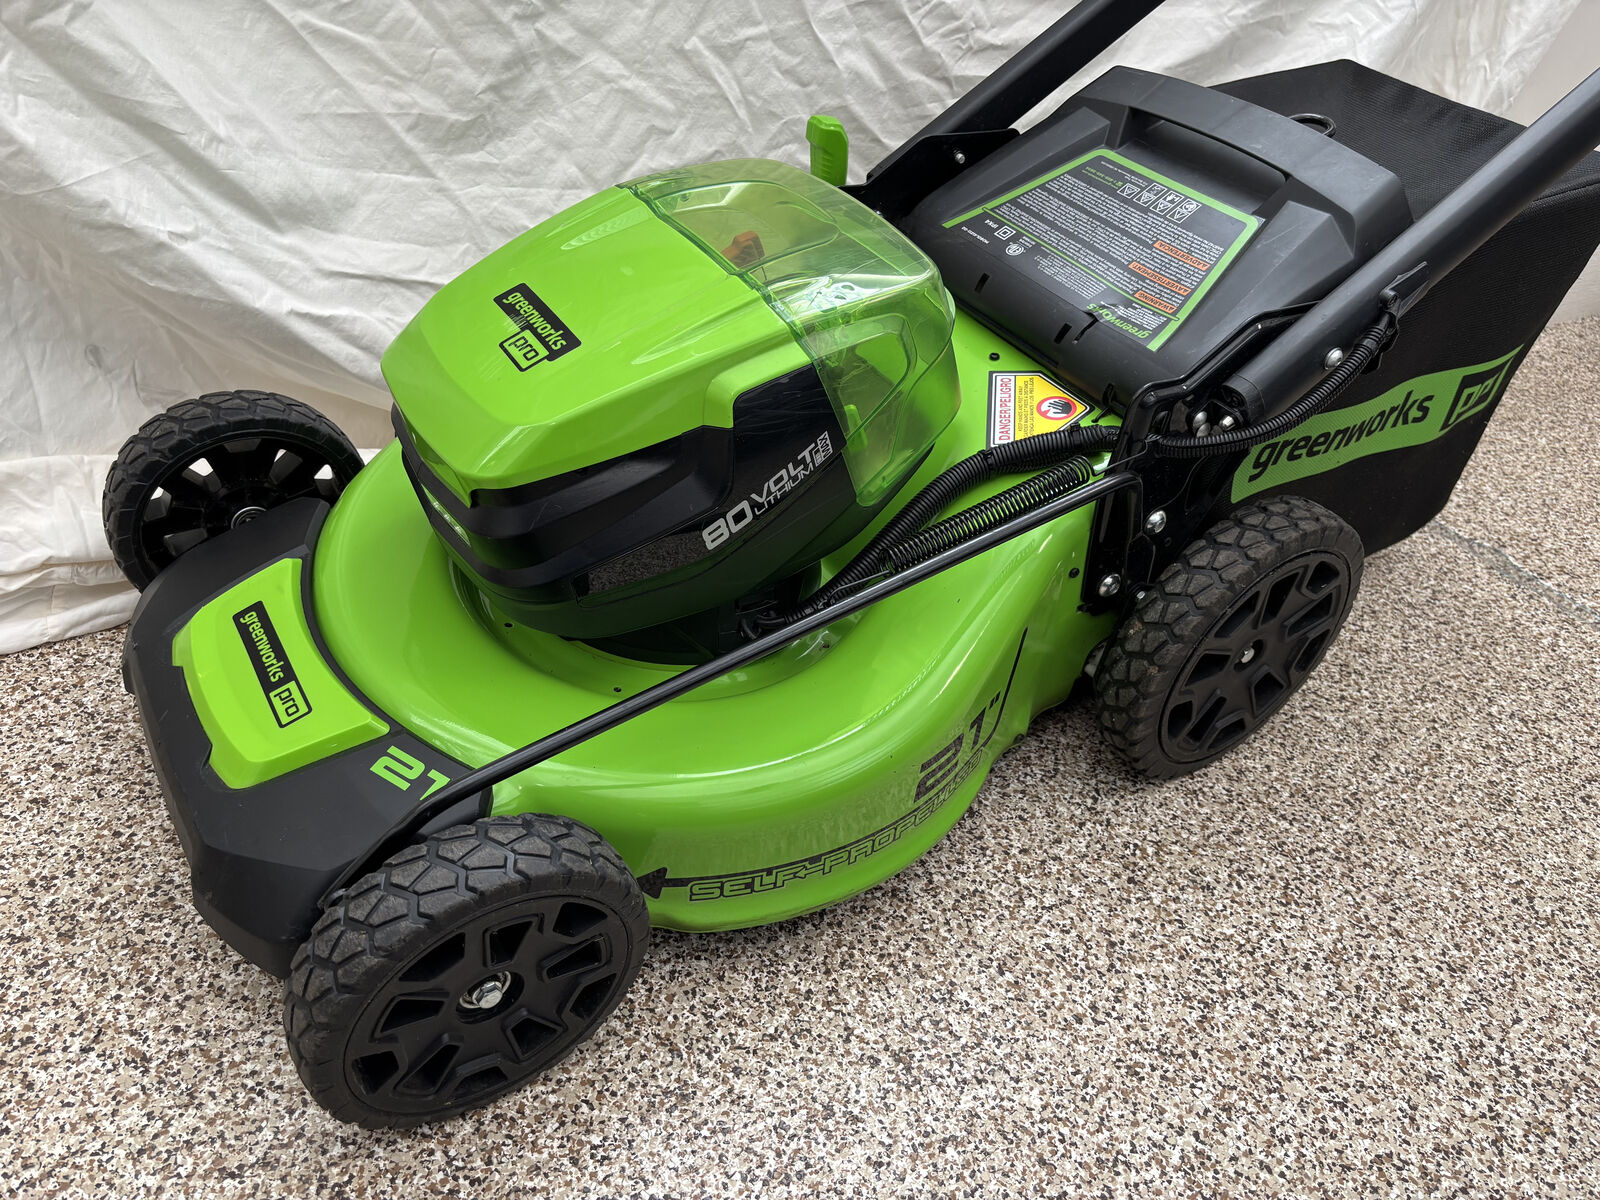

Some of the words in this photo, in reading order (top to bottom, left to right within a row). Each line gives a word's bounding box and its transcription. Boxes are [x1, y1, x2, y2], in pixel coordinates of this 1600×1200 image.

[502, 292, 566, 350] greenworks
[508, 336, 540, 361] pro
[998, 377, 1012, 441] DANGER/PELIGRO
[1247, 389, 1435, 483] greenworks
[818, 433, 832, 459] MAX
[702, 499, 753, 550] 80
[750, 442, 815, 503] VOLT
[754, 462, 814, 515] LITHIUM
[239, 611, 284, 683] greenworks
[273, 687, 299, 717] pro
[369, 745, 451, 801] 21
